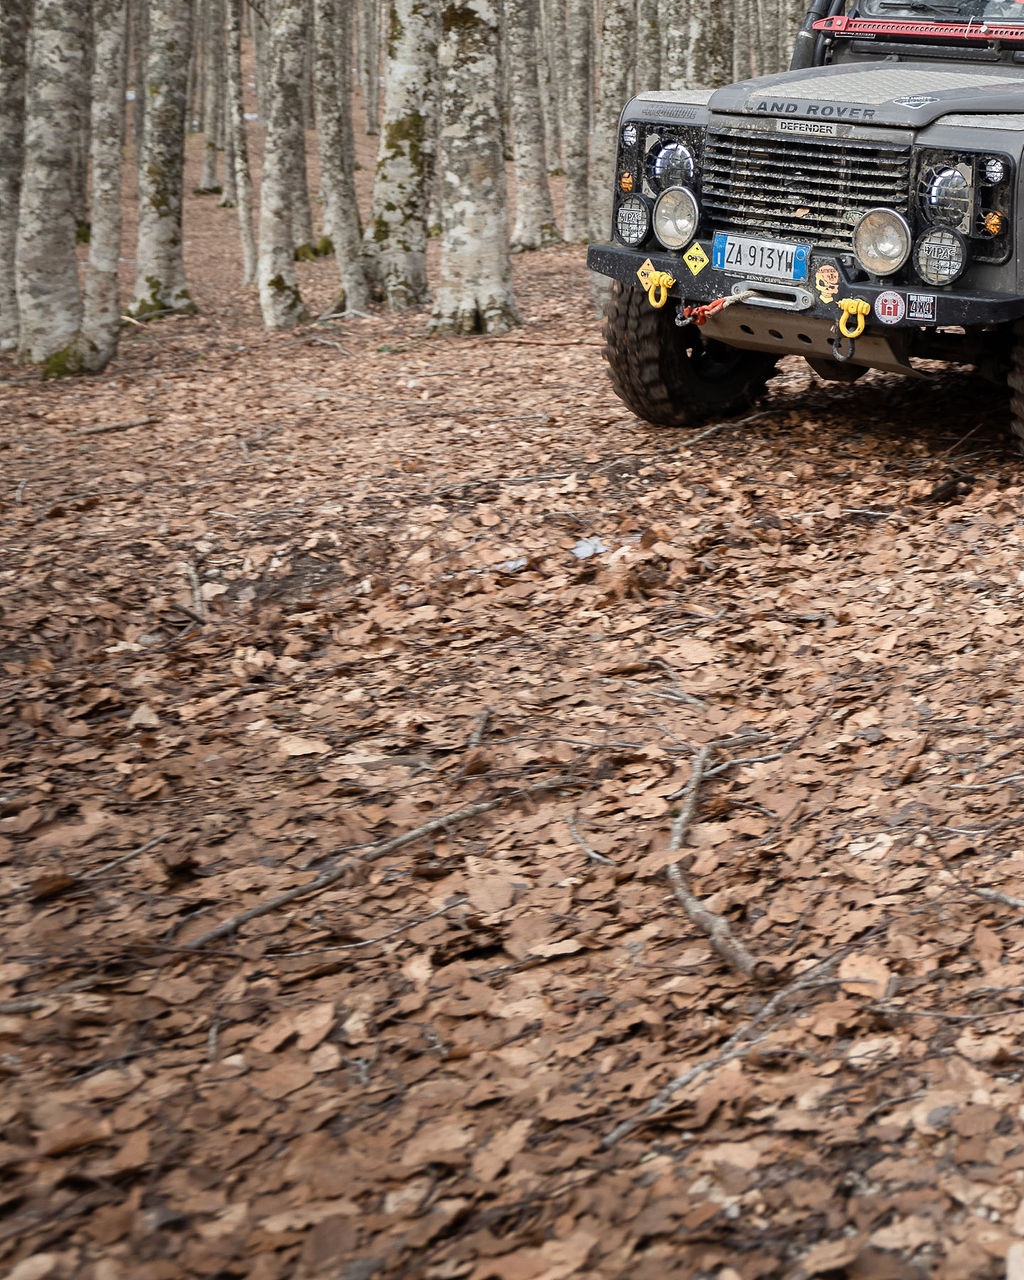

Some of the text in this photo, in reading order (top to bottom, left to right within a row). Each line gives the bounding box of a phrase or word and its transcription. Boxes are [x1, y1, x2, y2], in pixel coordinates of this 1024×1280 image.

[806, 104, 876, 119] ROVER
[780, 121, 833, 134] DEFENDER
[726, 242, 794, 272] ZA 913YW
